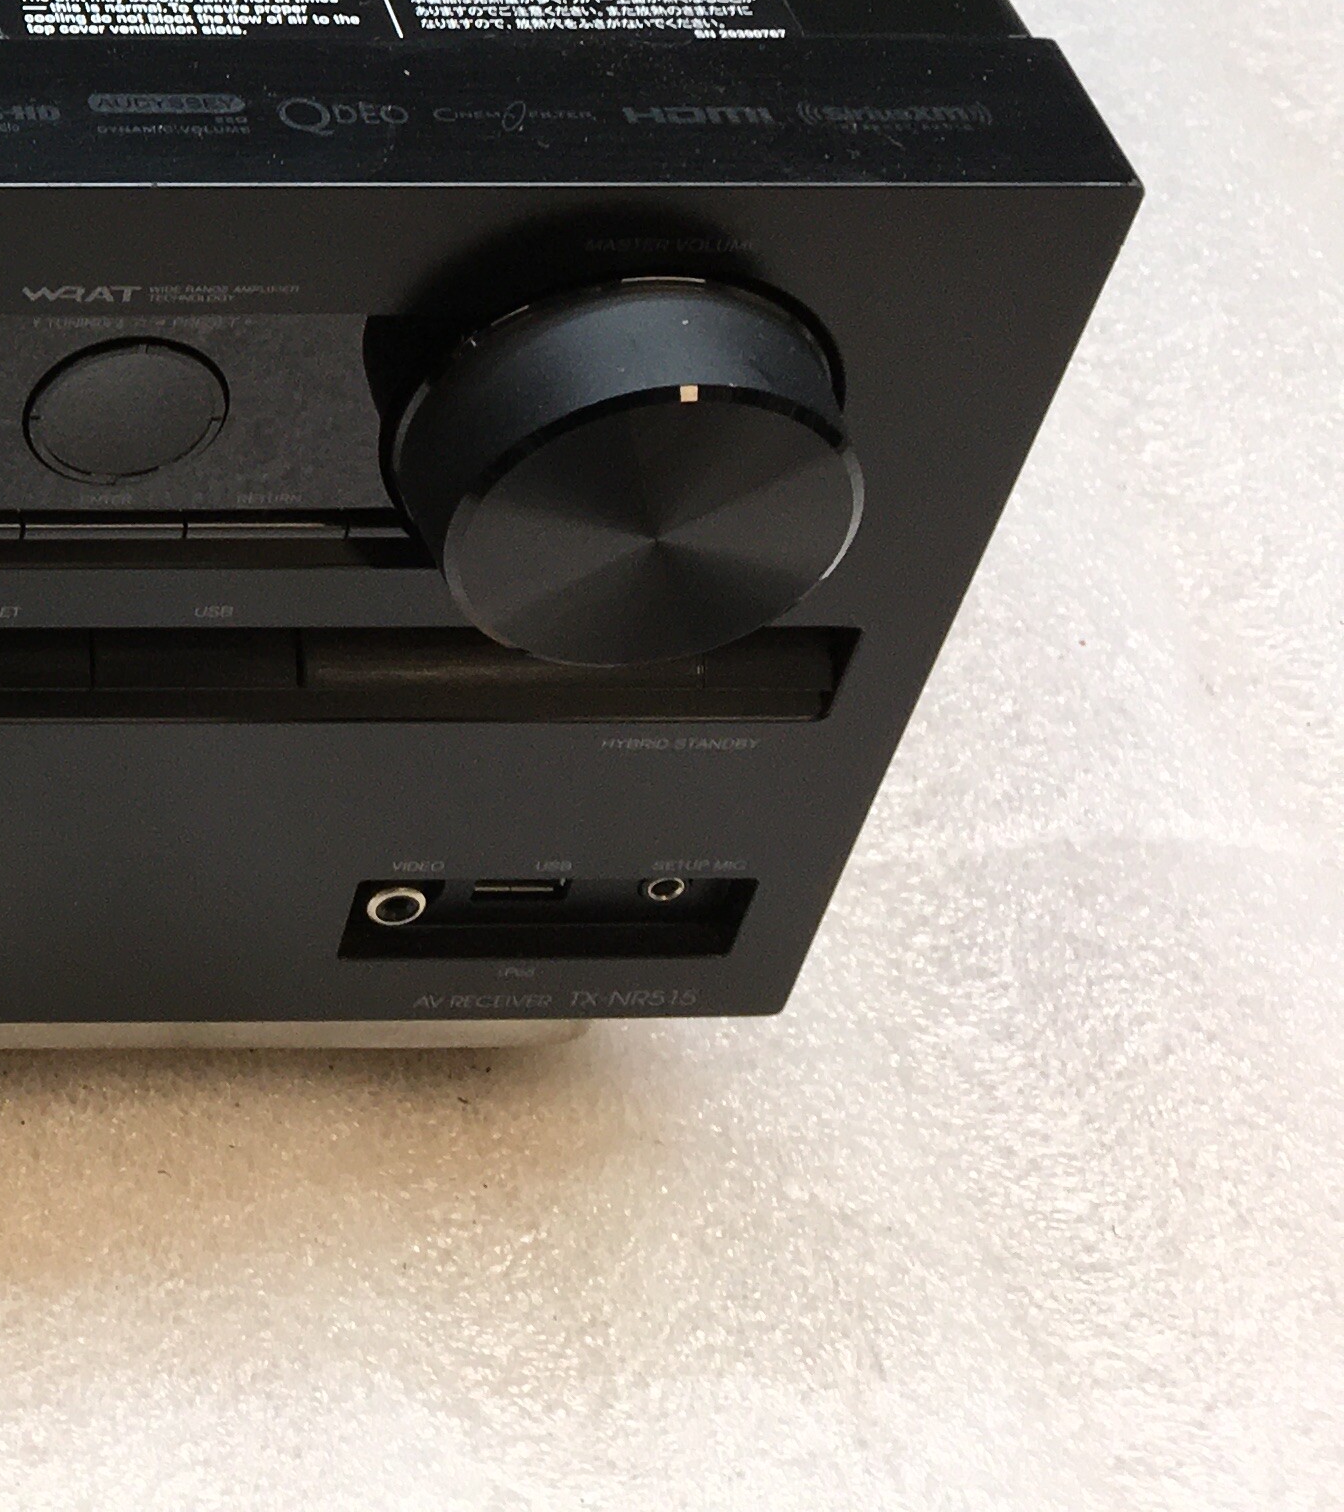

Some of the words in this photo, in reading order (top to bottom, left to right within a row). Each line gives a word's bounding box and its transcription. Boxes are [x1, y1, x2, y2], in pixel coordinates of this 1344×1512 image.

[50, 2, 81, 13] this
[86, 2, 100, 14] is
[193, 4, 250, 14] ensure
[254, 4, 307, 16] proper
[24, 13, 87, 26] cooling
[91, 13, 112, 24] do
[116, 13, 144, 24] not
[147, 13, 194, 25] block
[197, 13, 224, 25] the
[227, 13, 262, 25] flow
[266, 13, 283, 25] of
[288, 14, 308, 25] air
[312, 14, 330, 25] to
[333, 14, 360, 25] the
[26, 24, 56, 36] top
[59, 24, 105, 35] cover
[109, 24, 197, 35] ventilation
[201, 25, 247, 36] slots.
[276, 97, 409, 136] QDEO
[193, 605, 235, 619] USB
[600, 737, 670, 750] HYBRID
[674, 737, 762, 750] STANDBY
[392, 860, 445, 872] VIDEO
[535, 860, 573, 872] USB
[412, 994, 445, 1009] AV
[450, 994, 553, 1009] RECEIVER
